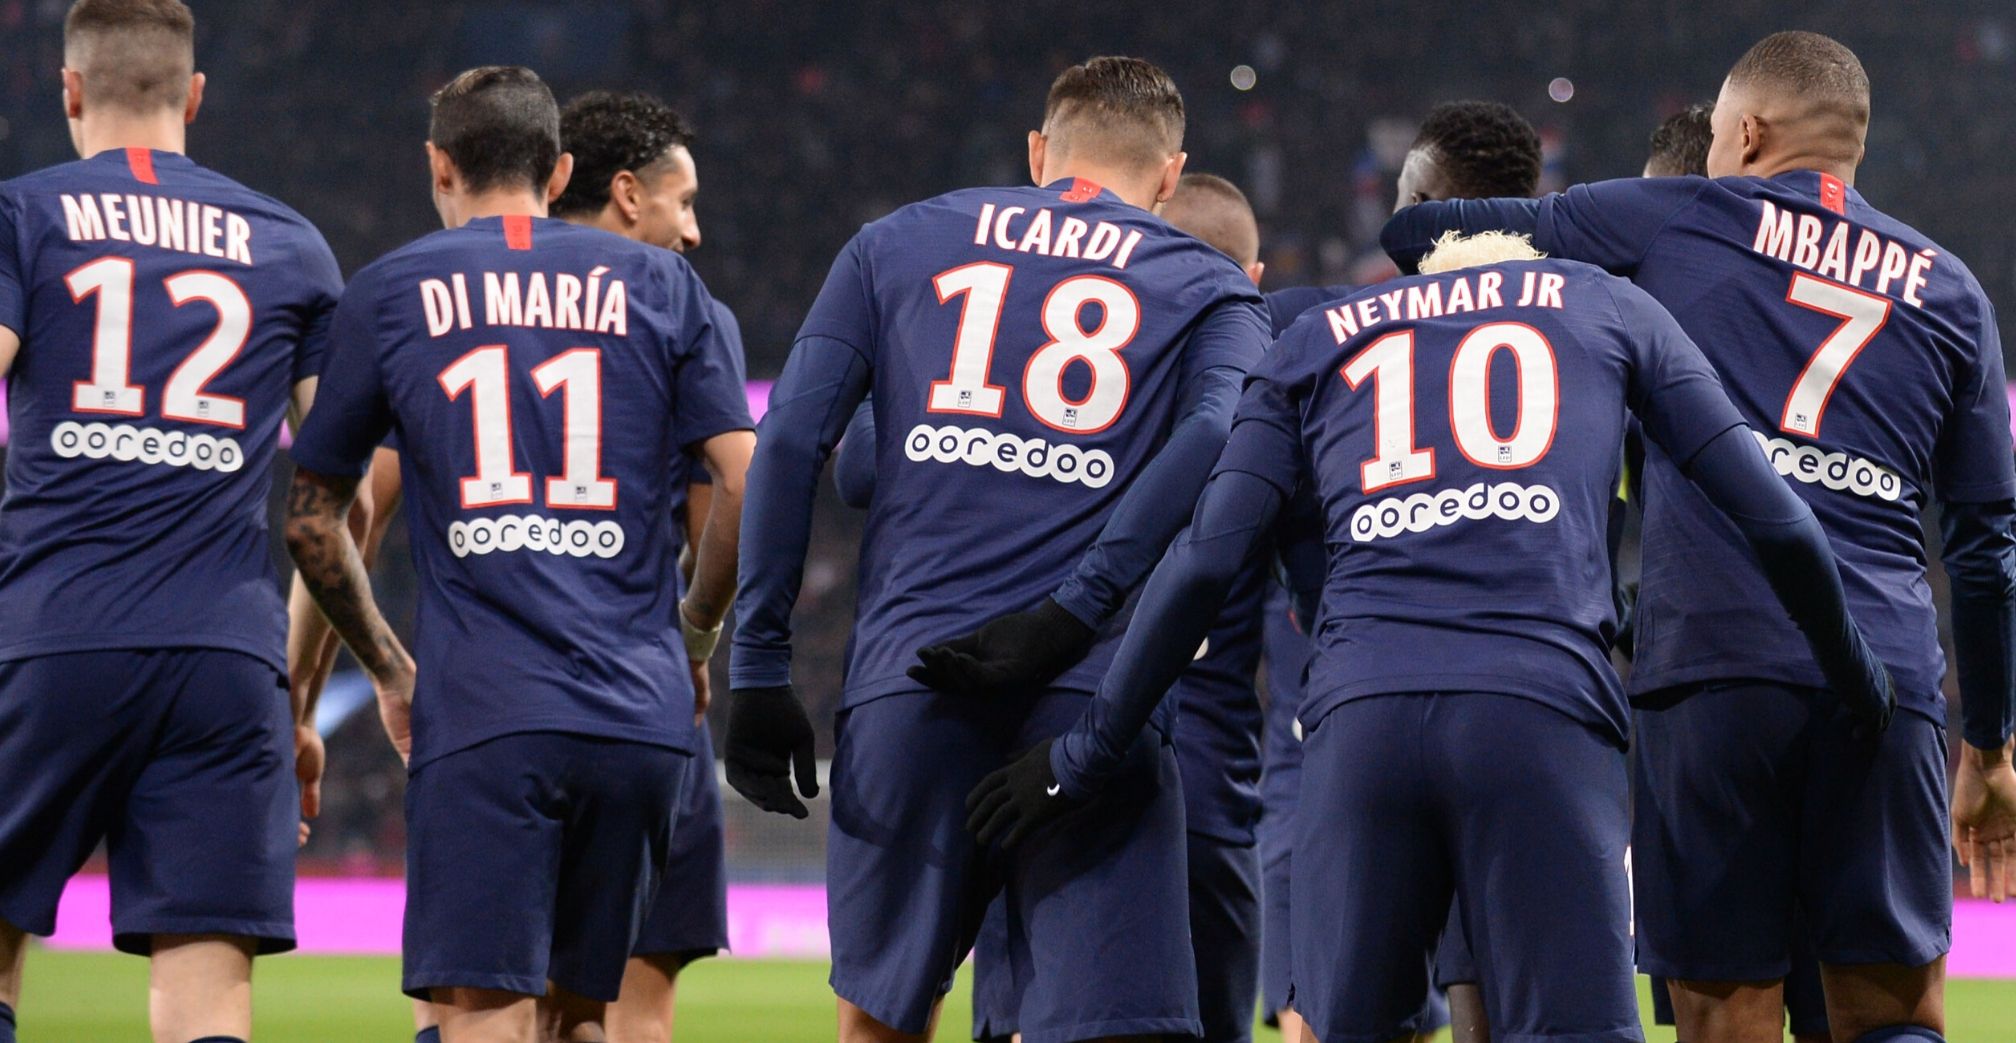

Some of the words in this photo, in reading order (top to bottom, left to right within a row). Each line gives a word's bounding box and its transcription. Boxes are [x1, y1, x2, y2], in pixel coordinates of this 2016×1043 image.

[61, 194, 252, 266] MEUNIER
[974, 203, 1144, 269] ICARDI
[1752, 199, 1938, 309] MBAPPÉ
[419, 276, 473, 338] DI
[484, 266, 628, 337] MARÍA
[1325, 270, 1505, 346] NEYMAR
[1515, 271, 1566, 310] JR
[64, 256, 253, 430] 12
[926, 260, 1142, 435] 18
[1779, 271, 1893, 439] 7
[437, 344, 619, 511] 11
[1339, 321, 1561, 496] 10
[57, 426, 239, 468] ooredoo
[908, 429, 1110, 483] ooredoo
[1762, 440, 1898, 495] redoo
[451, 517, 620, 554] ooredoo
[1353, 482, 1556, 538] ooredoo
